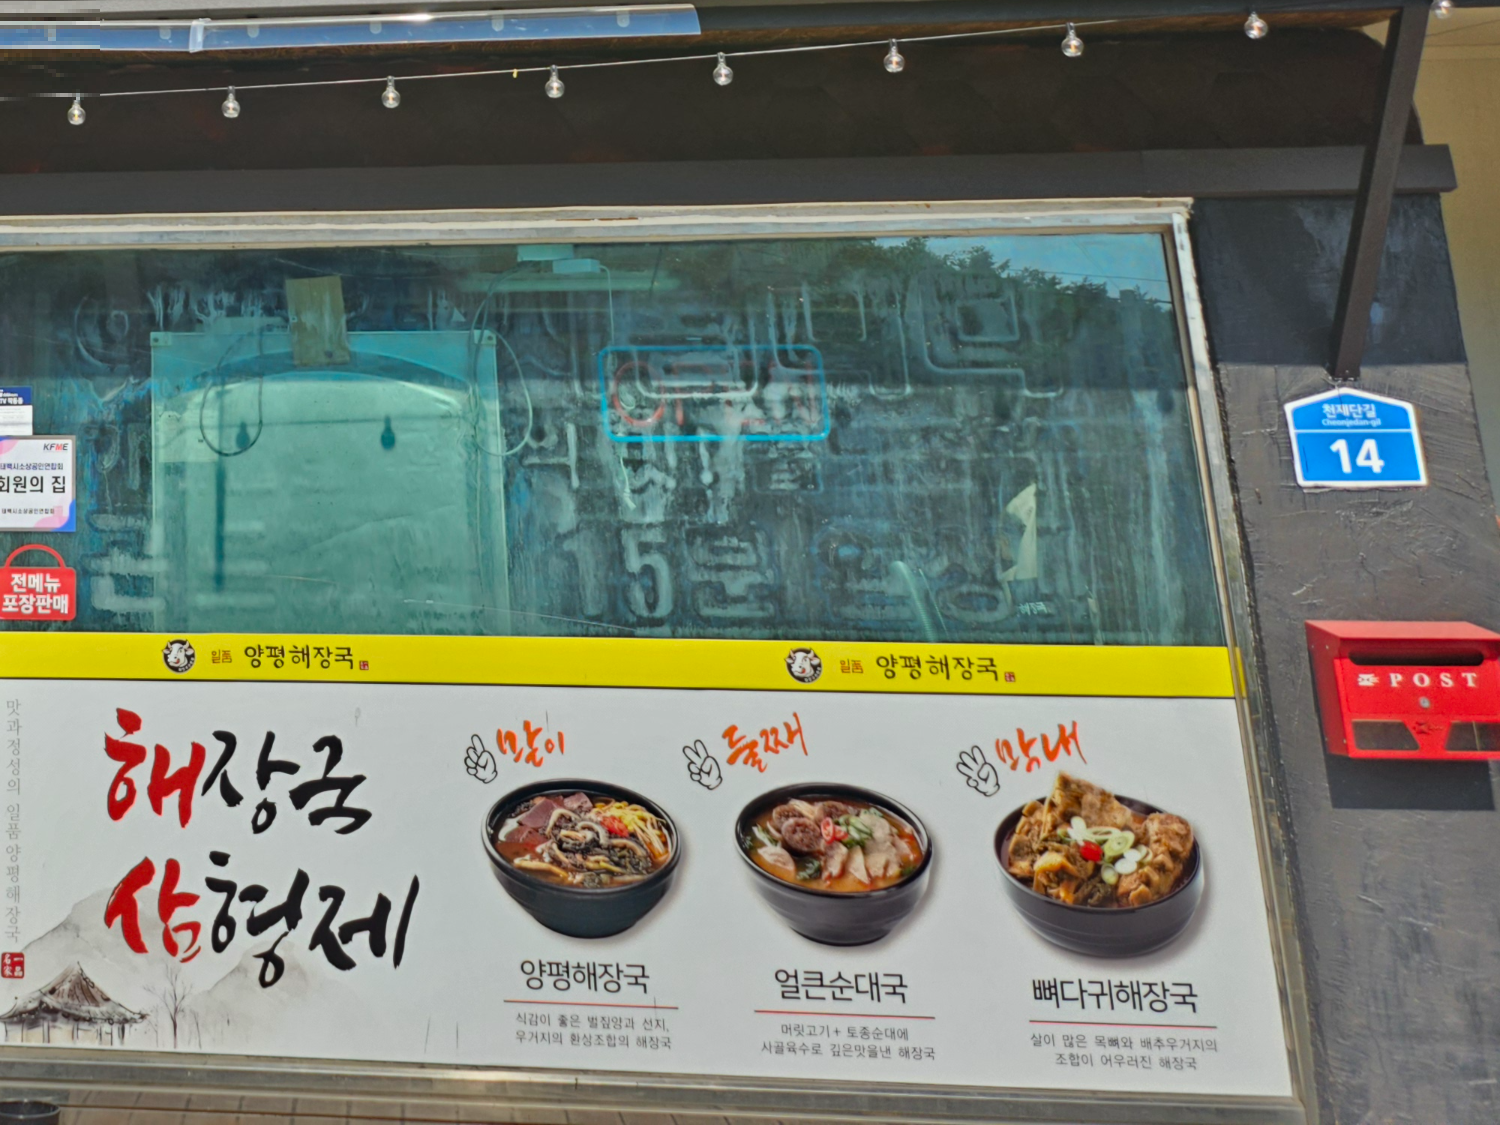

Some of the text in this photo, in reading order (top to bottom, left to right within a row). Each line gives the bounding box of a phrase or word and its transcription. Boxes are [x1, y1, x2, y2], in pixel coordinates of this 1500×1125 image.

[1322, 418, 1381, 427] Cheonjedan-gil
[43, 443, 69, 451] KFME
[1329, 438, 1385, 474] 14
[51, 476, 66, 494] 집
[10, 572, 61, 593] 전메뉴
[1, 593, 69, 614] 포장판매
[211, 649, 232, 664] 일품
[244, 644, 353, 669] 양평해장국
[840, 659, 864, 674] 일품
[876, 654, 998, 681] 양평해장국
[1389, 672, 1477, 687] POST
[722, 711, 808, 773] 둘째
[995, 720, 1088, 773] 막내
[103, 707, 372, 835] 해장국
[103, 850, 420, 988] 삼형제
[520, 959, 649, 994] 양평해장국
[775, 969, 908, 1004] 얼큰순대국
[1032, 978, 1198, 1013] 뼈다귀해장국
[516, 1012, 551, 1027] 식감이
[558, 1013, 581, 1028] 좋은
[515, 1030, 671, 1050] 우거지의 환상조합의 해장국
[847, 1027, 909, 1041] 토종순대에
[1030, 1033, 1218, 1053] 살이 많은 목뼈와 배추우거지의
[761, 1041, 823, 1056] 사골육수로
[898, 1046, 936, 1061] 해장국
[1055, 1052, 1198, 1071] 조합이 어우러진 해장국
